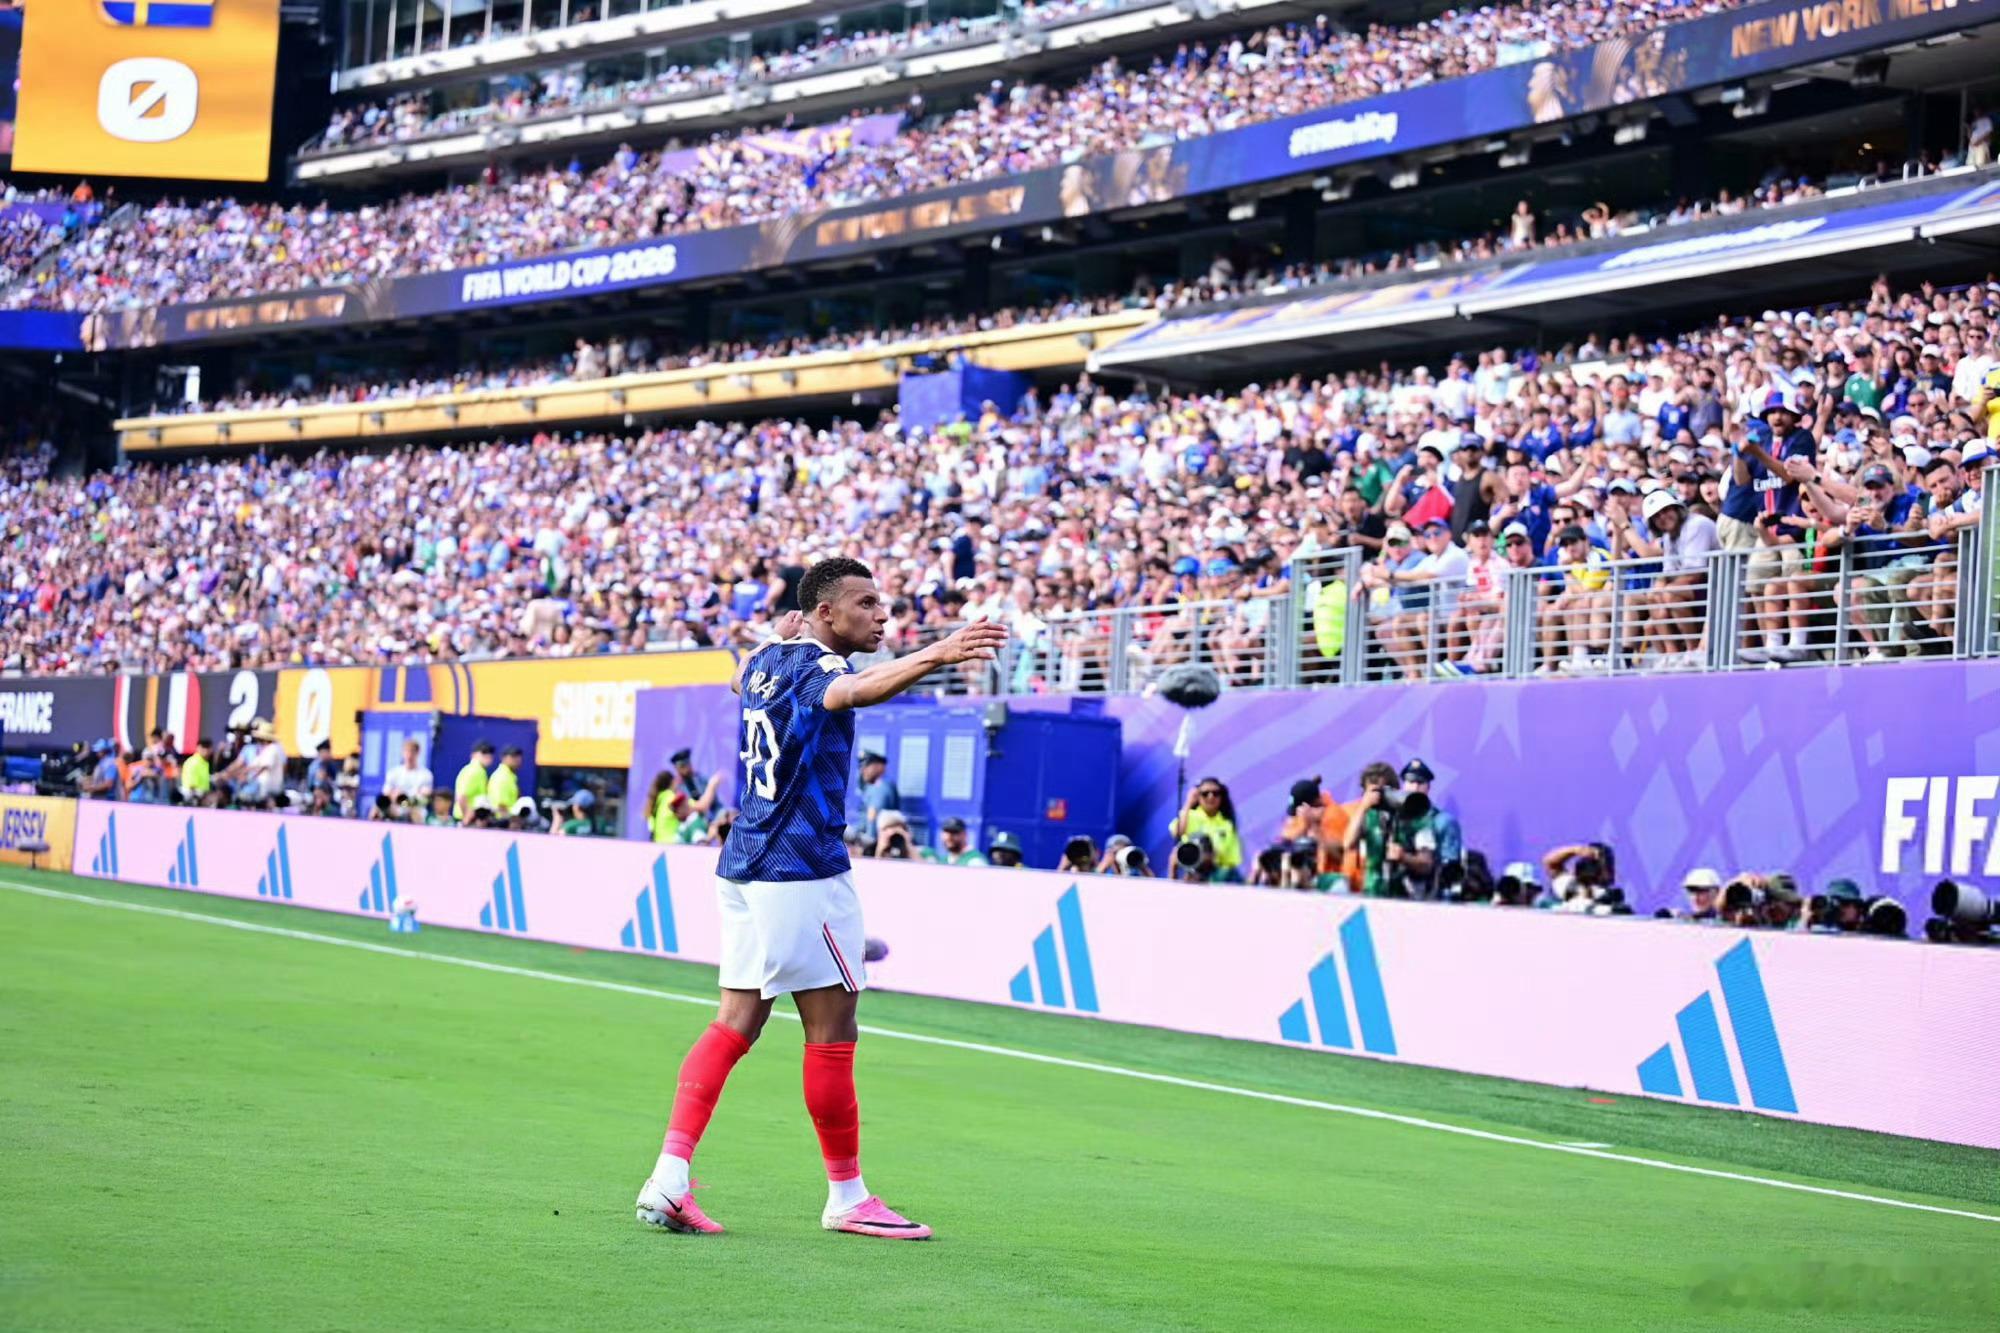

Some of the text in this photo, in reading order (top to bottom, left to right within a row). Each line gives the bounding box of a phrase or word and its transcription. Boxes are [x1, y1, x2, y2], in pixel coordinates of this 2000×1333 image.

[1731, 11, 1798, 58] NEW
[1802, 0, 1882, 40] YORK
[98, 57, 198, 142] 0
[463, 245, 676, 301] FIFA WORLD CUP 2026
[229, 671, 258, 741] 2
[297, 668, 332, 757] 0
[553, 681, 652, 740] SWEDE
